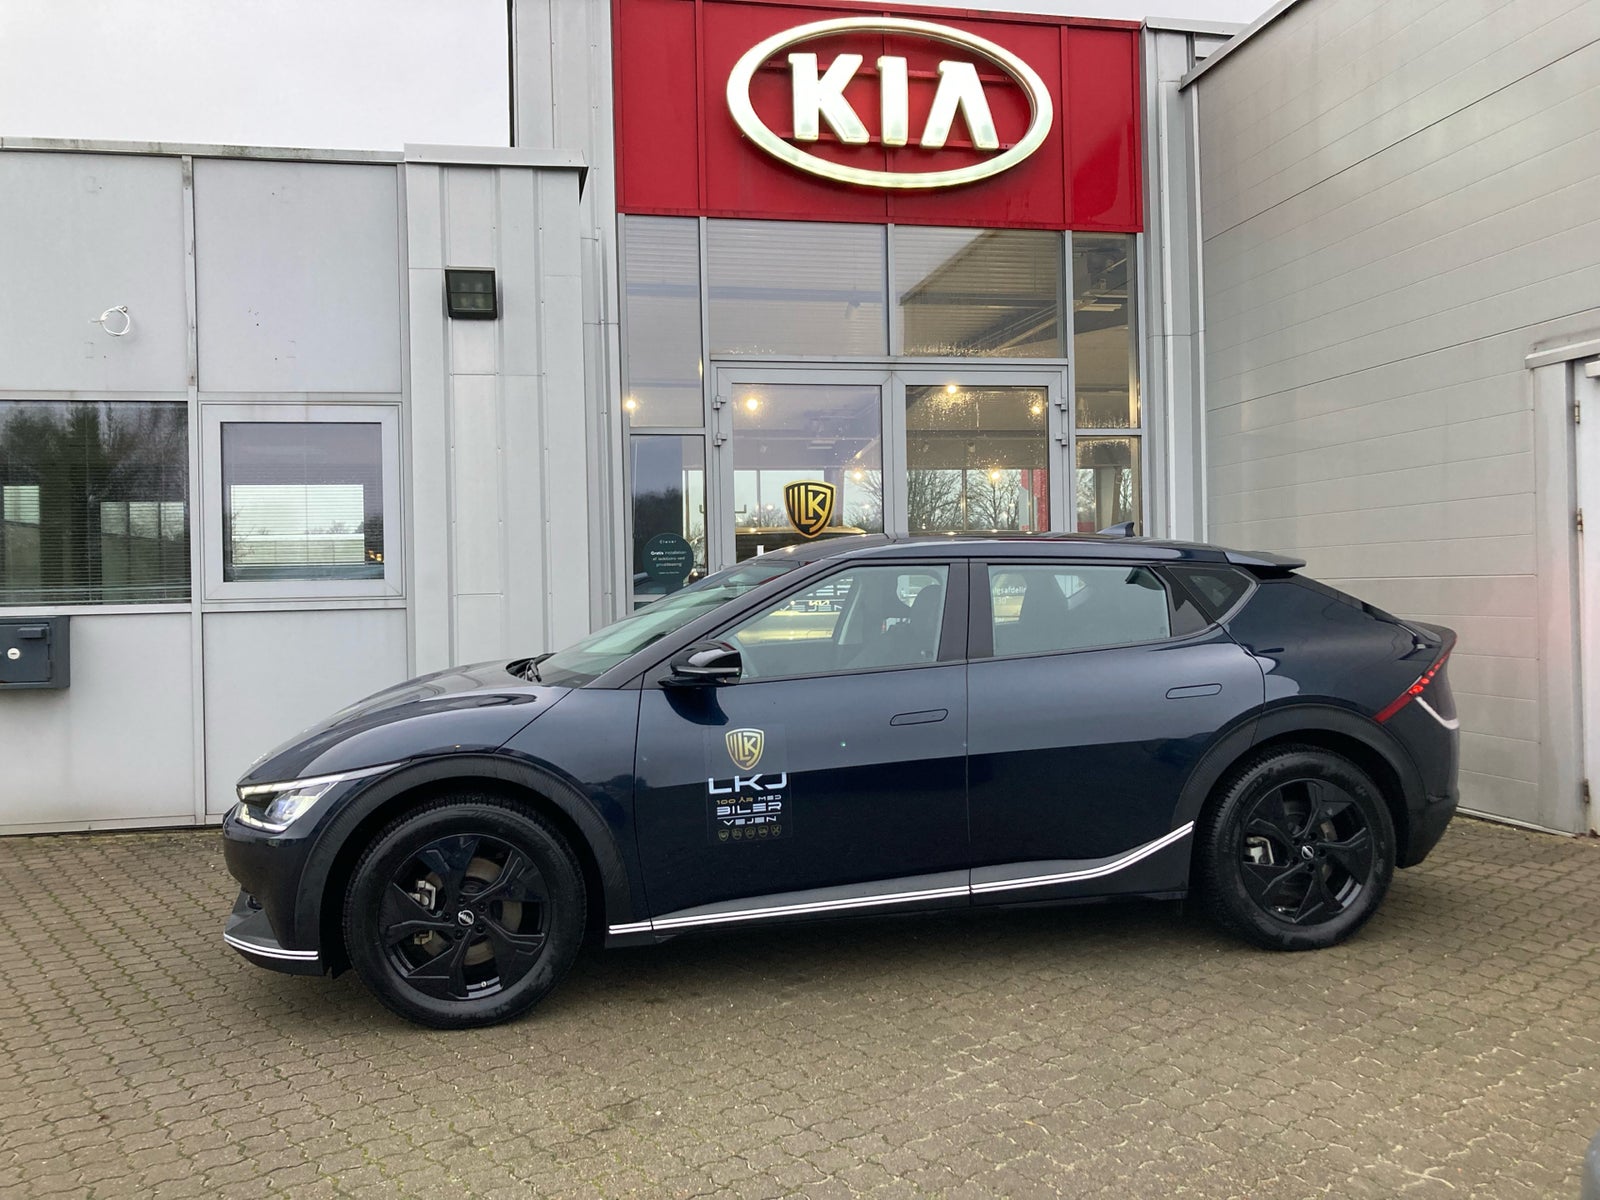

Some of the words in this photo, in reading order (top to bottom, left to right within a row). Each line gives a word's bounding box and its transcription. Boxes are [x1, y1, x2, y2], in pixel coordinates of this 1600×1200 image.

[788, 53, 999, 149] KIA
[708, 772, 787, 795] LKJ
[717, 802, 782, 816] BILER
[723, 816, 777, 826] VEJEN
